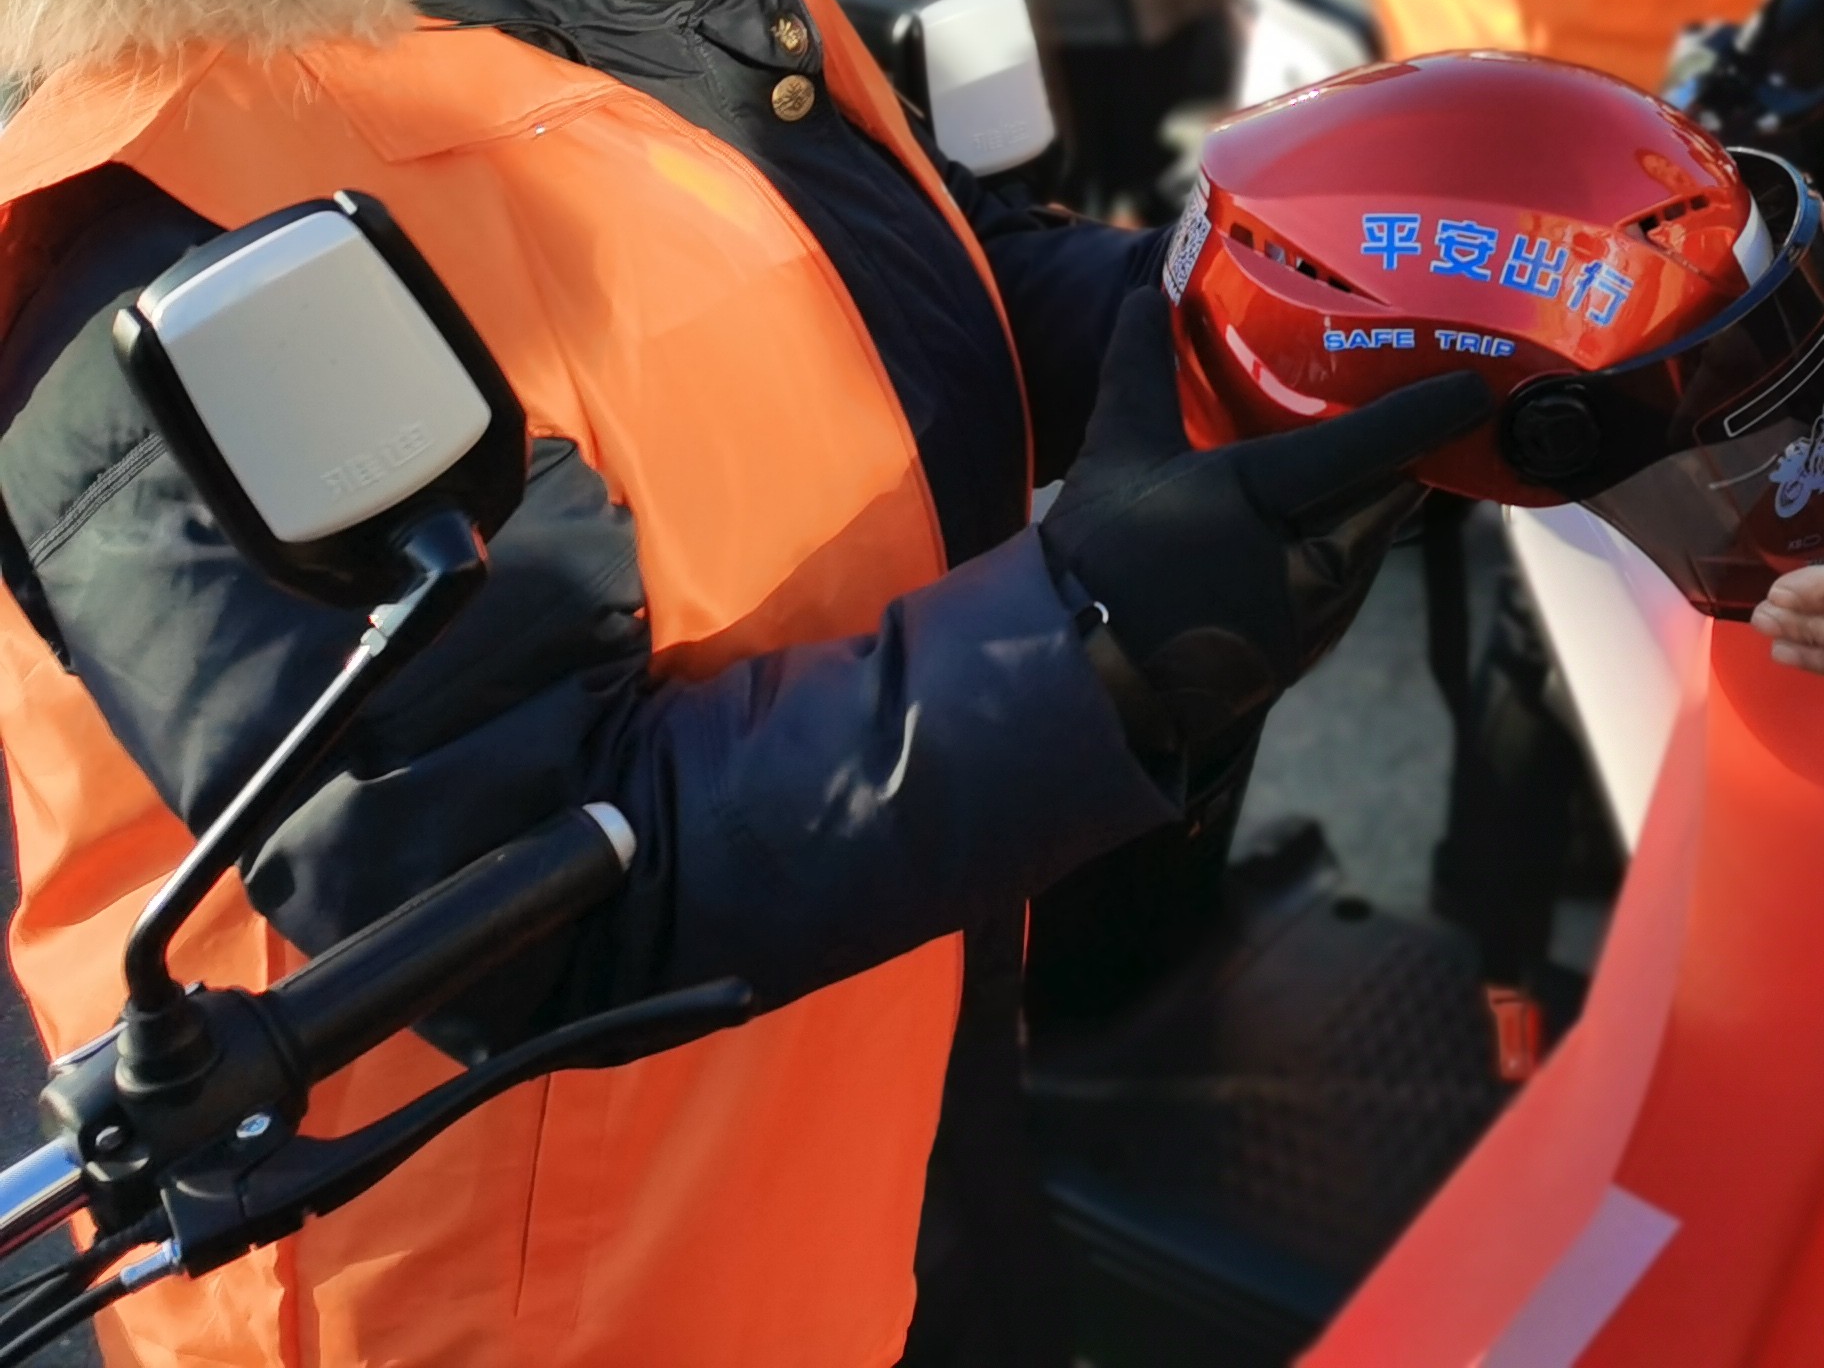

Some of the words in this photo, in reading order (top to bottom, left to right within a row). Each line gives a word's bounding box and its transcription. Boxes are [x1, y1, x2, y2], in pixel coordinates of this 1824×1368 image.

[1360, 213, 1635, 327] 平安出行
[1323, 328, 1415, 351] SAFE
[1435, 329, 1516, 358] TRIP
